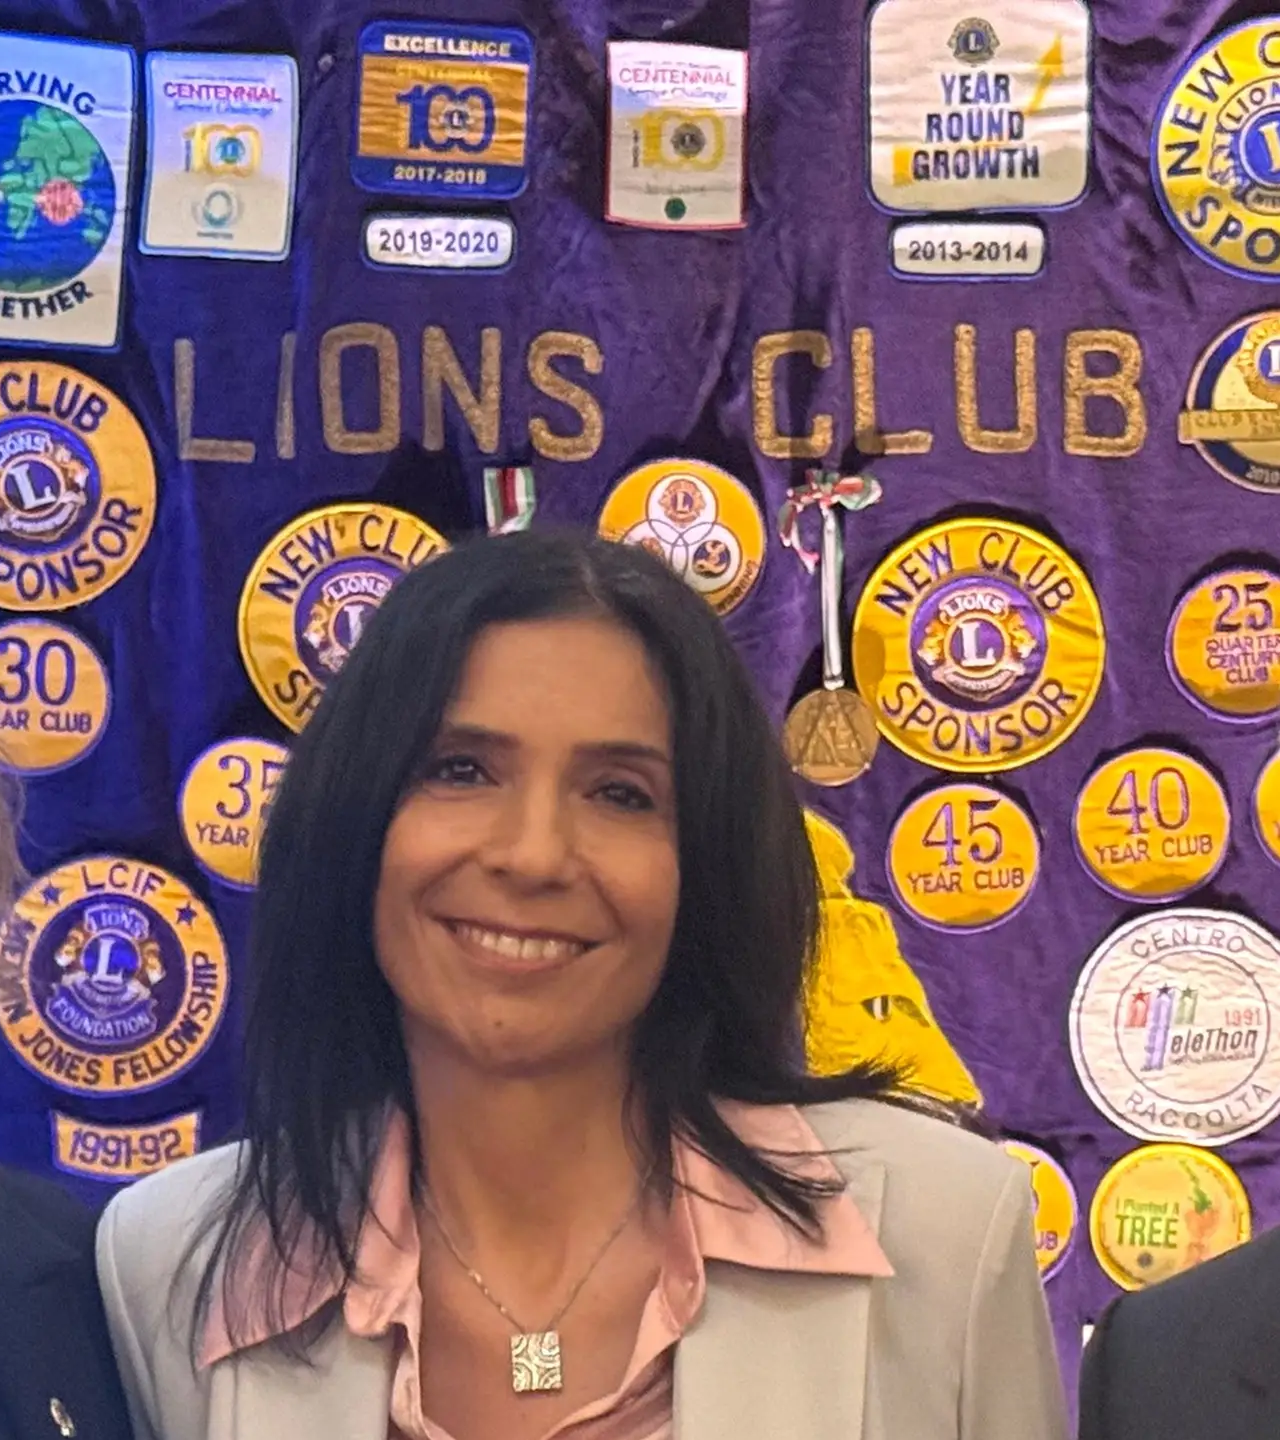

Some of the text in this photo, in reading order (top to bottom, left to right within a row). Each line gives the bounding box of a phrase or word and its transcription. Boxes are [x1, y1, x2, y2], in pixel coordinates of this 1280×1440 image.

[383, 34, 511, 57] EXCELLENCE
[163, 82, 283, 103] CENTENNIAL
[619, 67, 737, 87] CENTENNIAL
[940, 71, 1011, 106] YEAR
[396, 84, 497, 154] 100
[925, 108, 1025, 144] ROUND
[1164, 50, 1235, 180] NEW
[394, 165, 487, 184] 2017-2018
[912, 145, 1040, 181] GROWTH
[379, 228, 499, 253] 2019-2020
[908, 240, 1029, 262] 2013-2014
[173, 322, 1149, 463] LIONS CLUB
[259, 519, 337, 605] NEW
[873, 532, 1076, 618] NEW CLUB
[942, 592, 1007, 618] LIONS
[1212, 580, 1274, 633] 25
[40, 711, 93, 734] CLUB
[881, 678, 1078, 756] SPONSOR
[1106, 766, 1191, 836] 40
[195, 822, 250, 847] YEAR
[921, 798, 1004, 868] 45
[1094, 833, 1214, 866] YEAR CLUB
[80, 861, 167, 897] LCIF
[907, 866, 1026, 895] YEAR CLUB
[88, 906, 147, 938] LIONS
[1130, 925, 1247, 960] CENTRO
[18, 1026, 103, 1086] JONES
[112, 950, 219, 1086] FELLOWSHIP
[53, 995, 152, 1038] FOUNDATION
[1124, 1082, 1272, 1131] RACCOLTA
[1115, 1214, 1180, 1249] TREE
